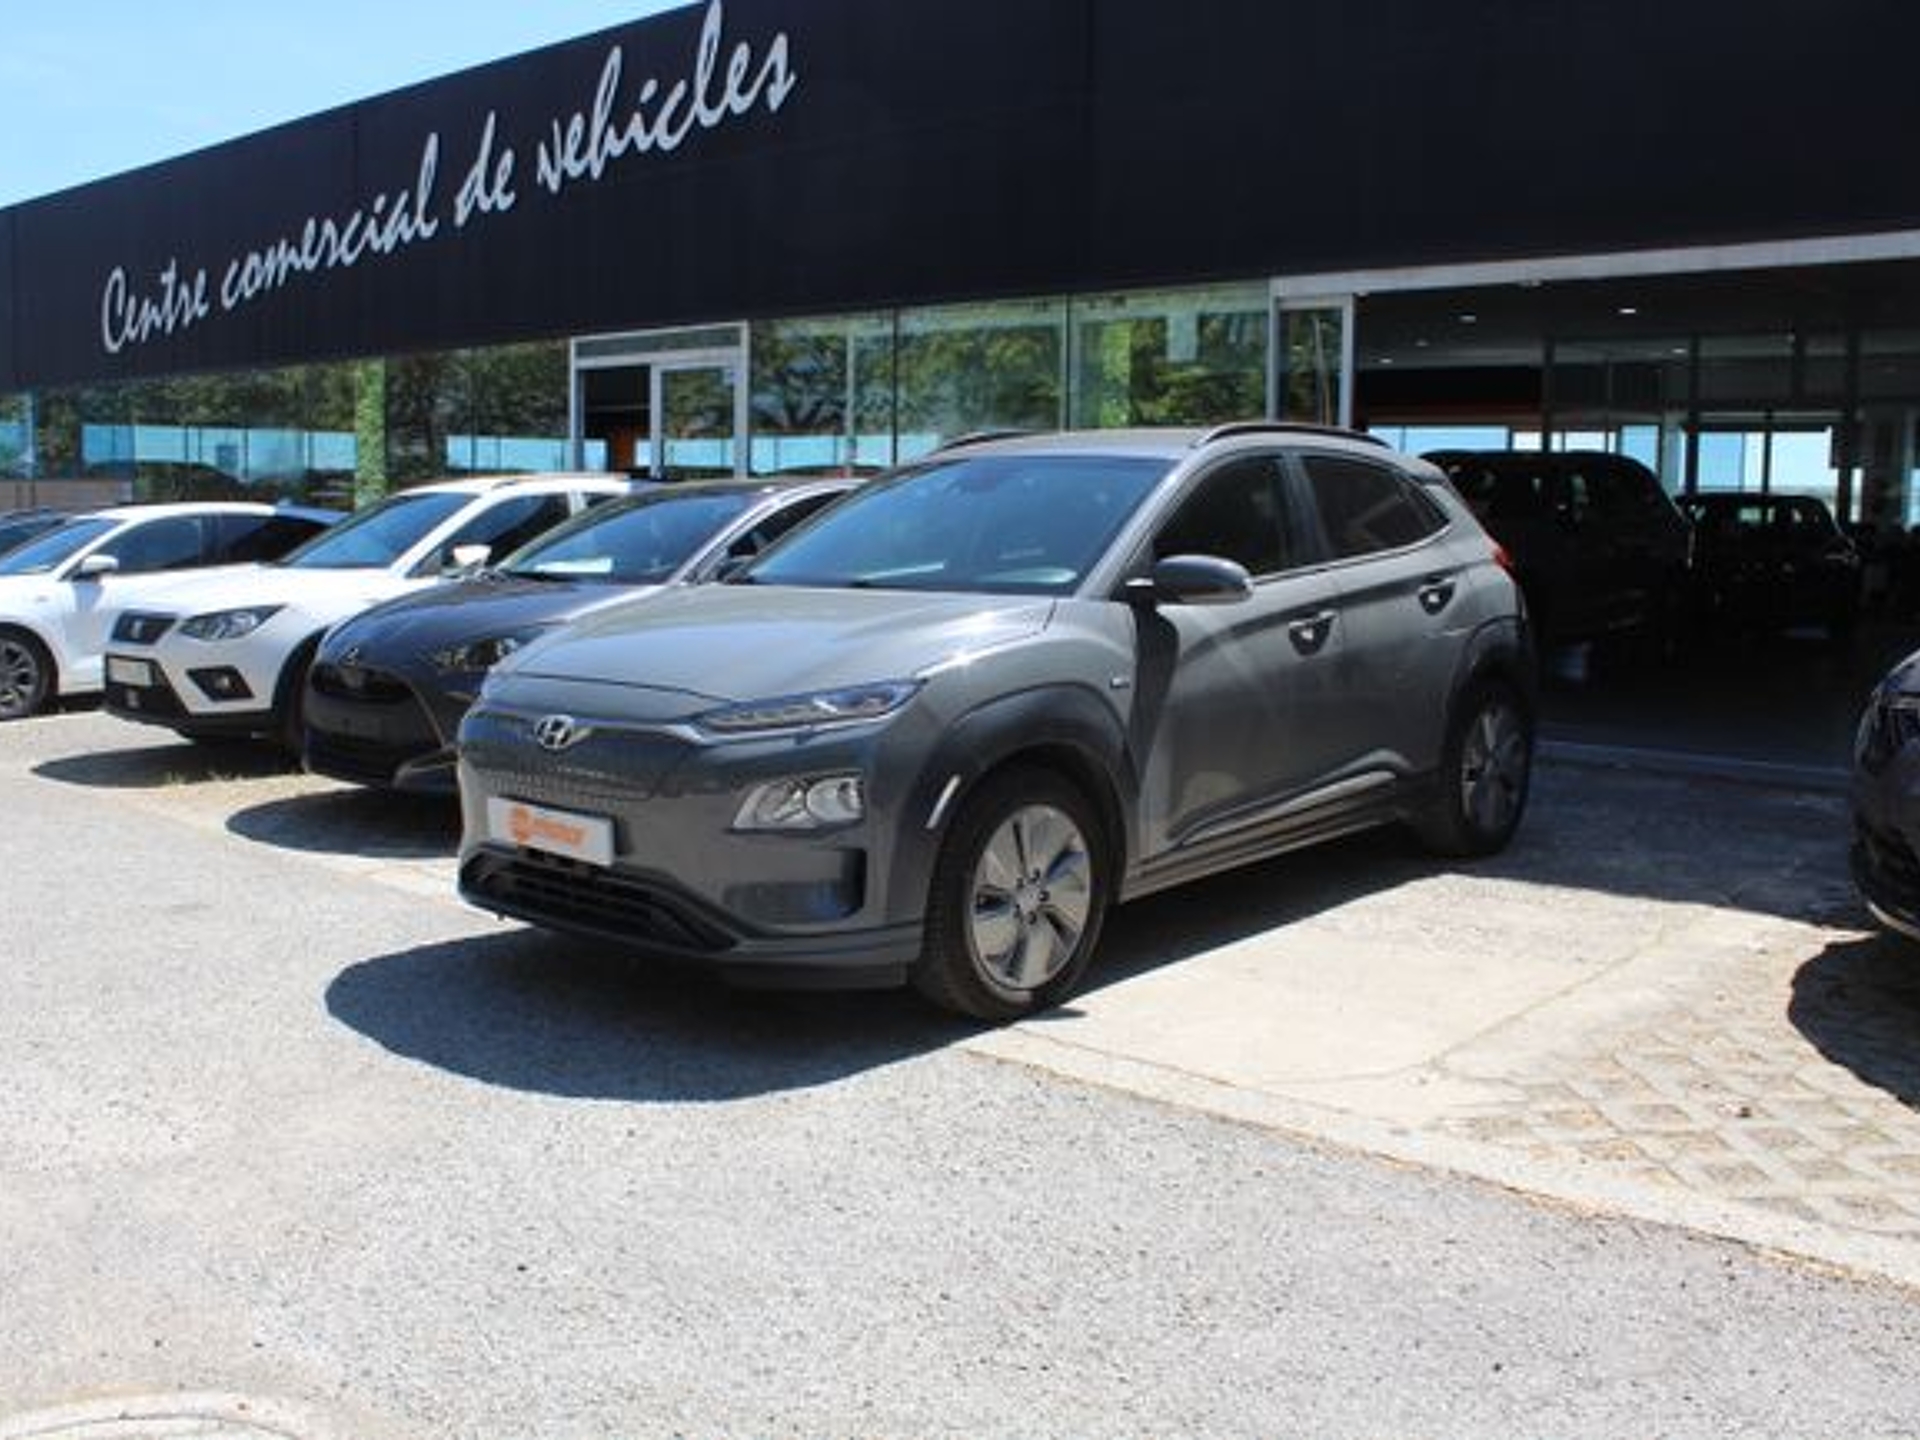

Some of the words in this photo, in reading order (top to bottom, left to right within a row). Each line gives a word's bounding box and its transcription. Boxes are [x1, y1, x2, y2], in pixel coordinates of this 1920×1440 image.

[102, 259, 209, 352] Centre
[221, 132, 438, 309] comercial
[454, 111, 516, 226] de
[536, 0, 796, 192] vehicles
